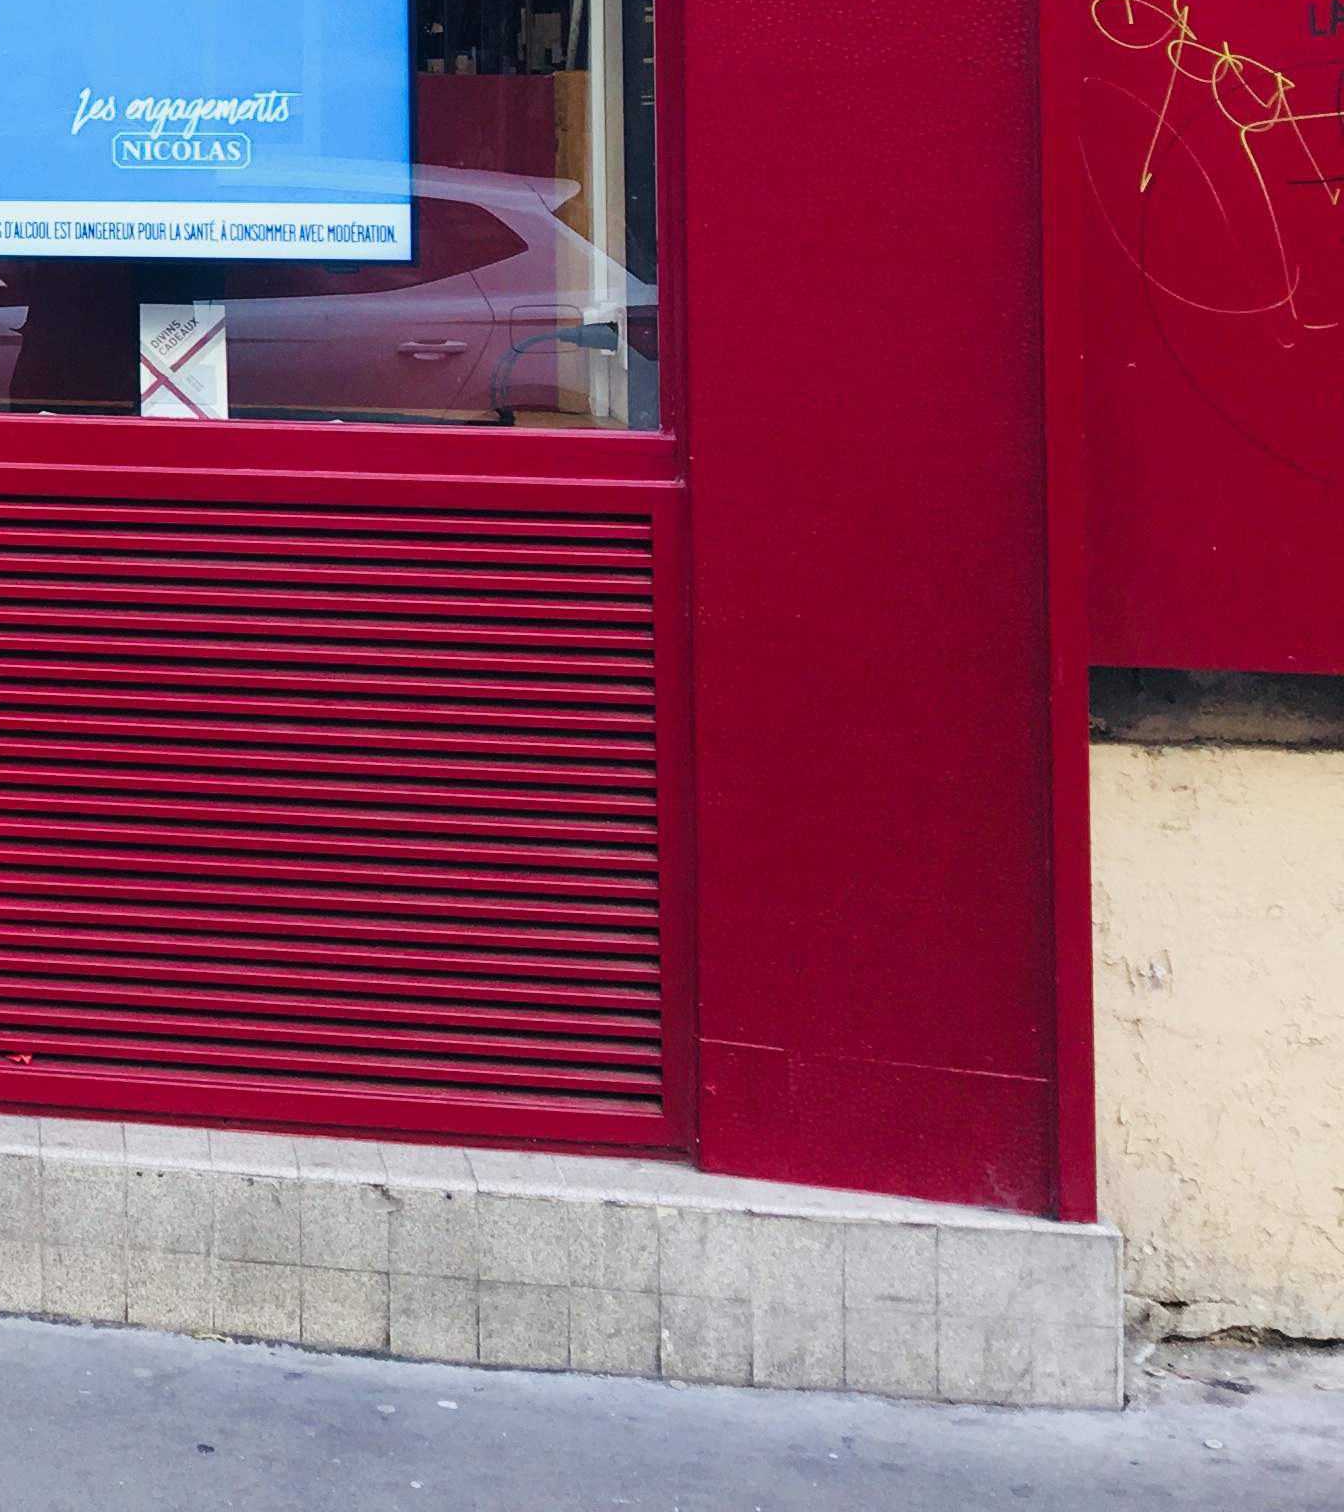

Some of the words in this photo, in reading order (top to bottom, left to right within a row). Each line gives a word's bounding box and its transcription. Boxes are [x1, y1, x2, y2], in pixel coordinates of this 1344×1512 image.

[71, 88, 116, 135] Les
[125, 90, 303, 139] engagements
[121, 139, 241, 161] NICOLAS
[4, 220, 52, 239] D'ALCOOL
[54, 221, 72, 240] EST
[75, 221, 135, 240] DANGEREUX
[138, 222, 166, 241] POUR
[169, 223, 181, 241] LA
[220, 219, 228, 241] À
[229, 223, 297, 242] CONSOMMER
[299, 223, 325, 243] AVEC
[327, 220, 398, 243] MODÉRATION.
[150, 319, 181, 349] DIVINS
[158, 317, 200, 356] CADEAUX
